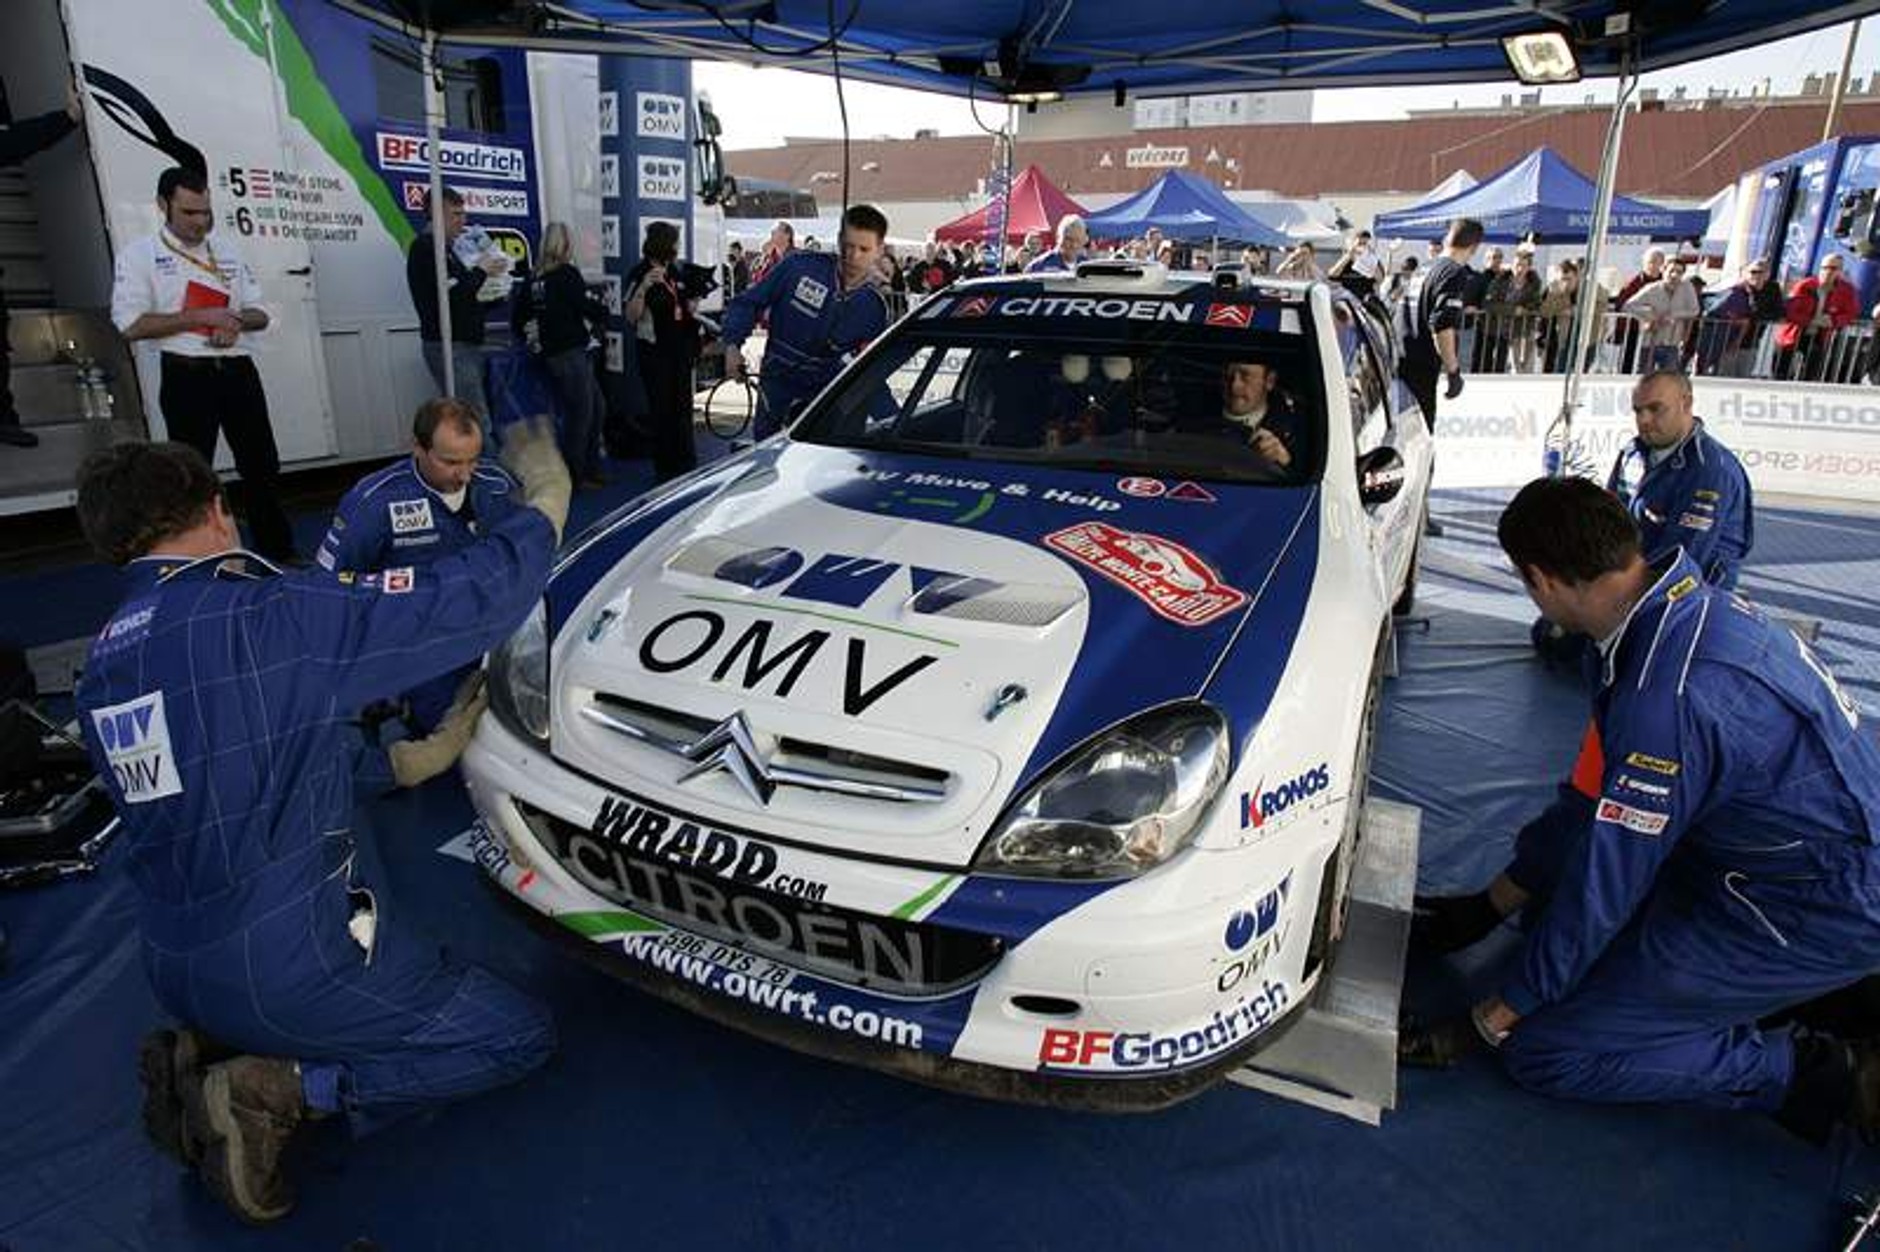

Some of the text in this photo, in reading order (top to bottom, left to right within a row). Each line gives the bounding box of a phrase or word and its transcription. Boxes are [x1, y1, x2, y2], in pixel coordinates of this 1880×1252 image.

[643, 116, 681, 134] OMV
[486, 194, 526, 210] SPORT
[643, 180, 681, 195] OMV
[1000, 297, 1194, 322] CITROEN
[905, 472, 990, 491] Move
[1001, 483, 1031, 497] &
[1043, 487, 1122, 512] Help
[637, 609, 939, 717] OMV
[1240, 762, 1329, 830] KRONOS
[664, 930, 790, 984] 596 DYS 78
[1217, 919, 1291, 992] OMV
[621, 934, 924, 1049] www.owrt.com
[1039, 981, 1289, 1067] BFGoodrich
